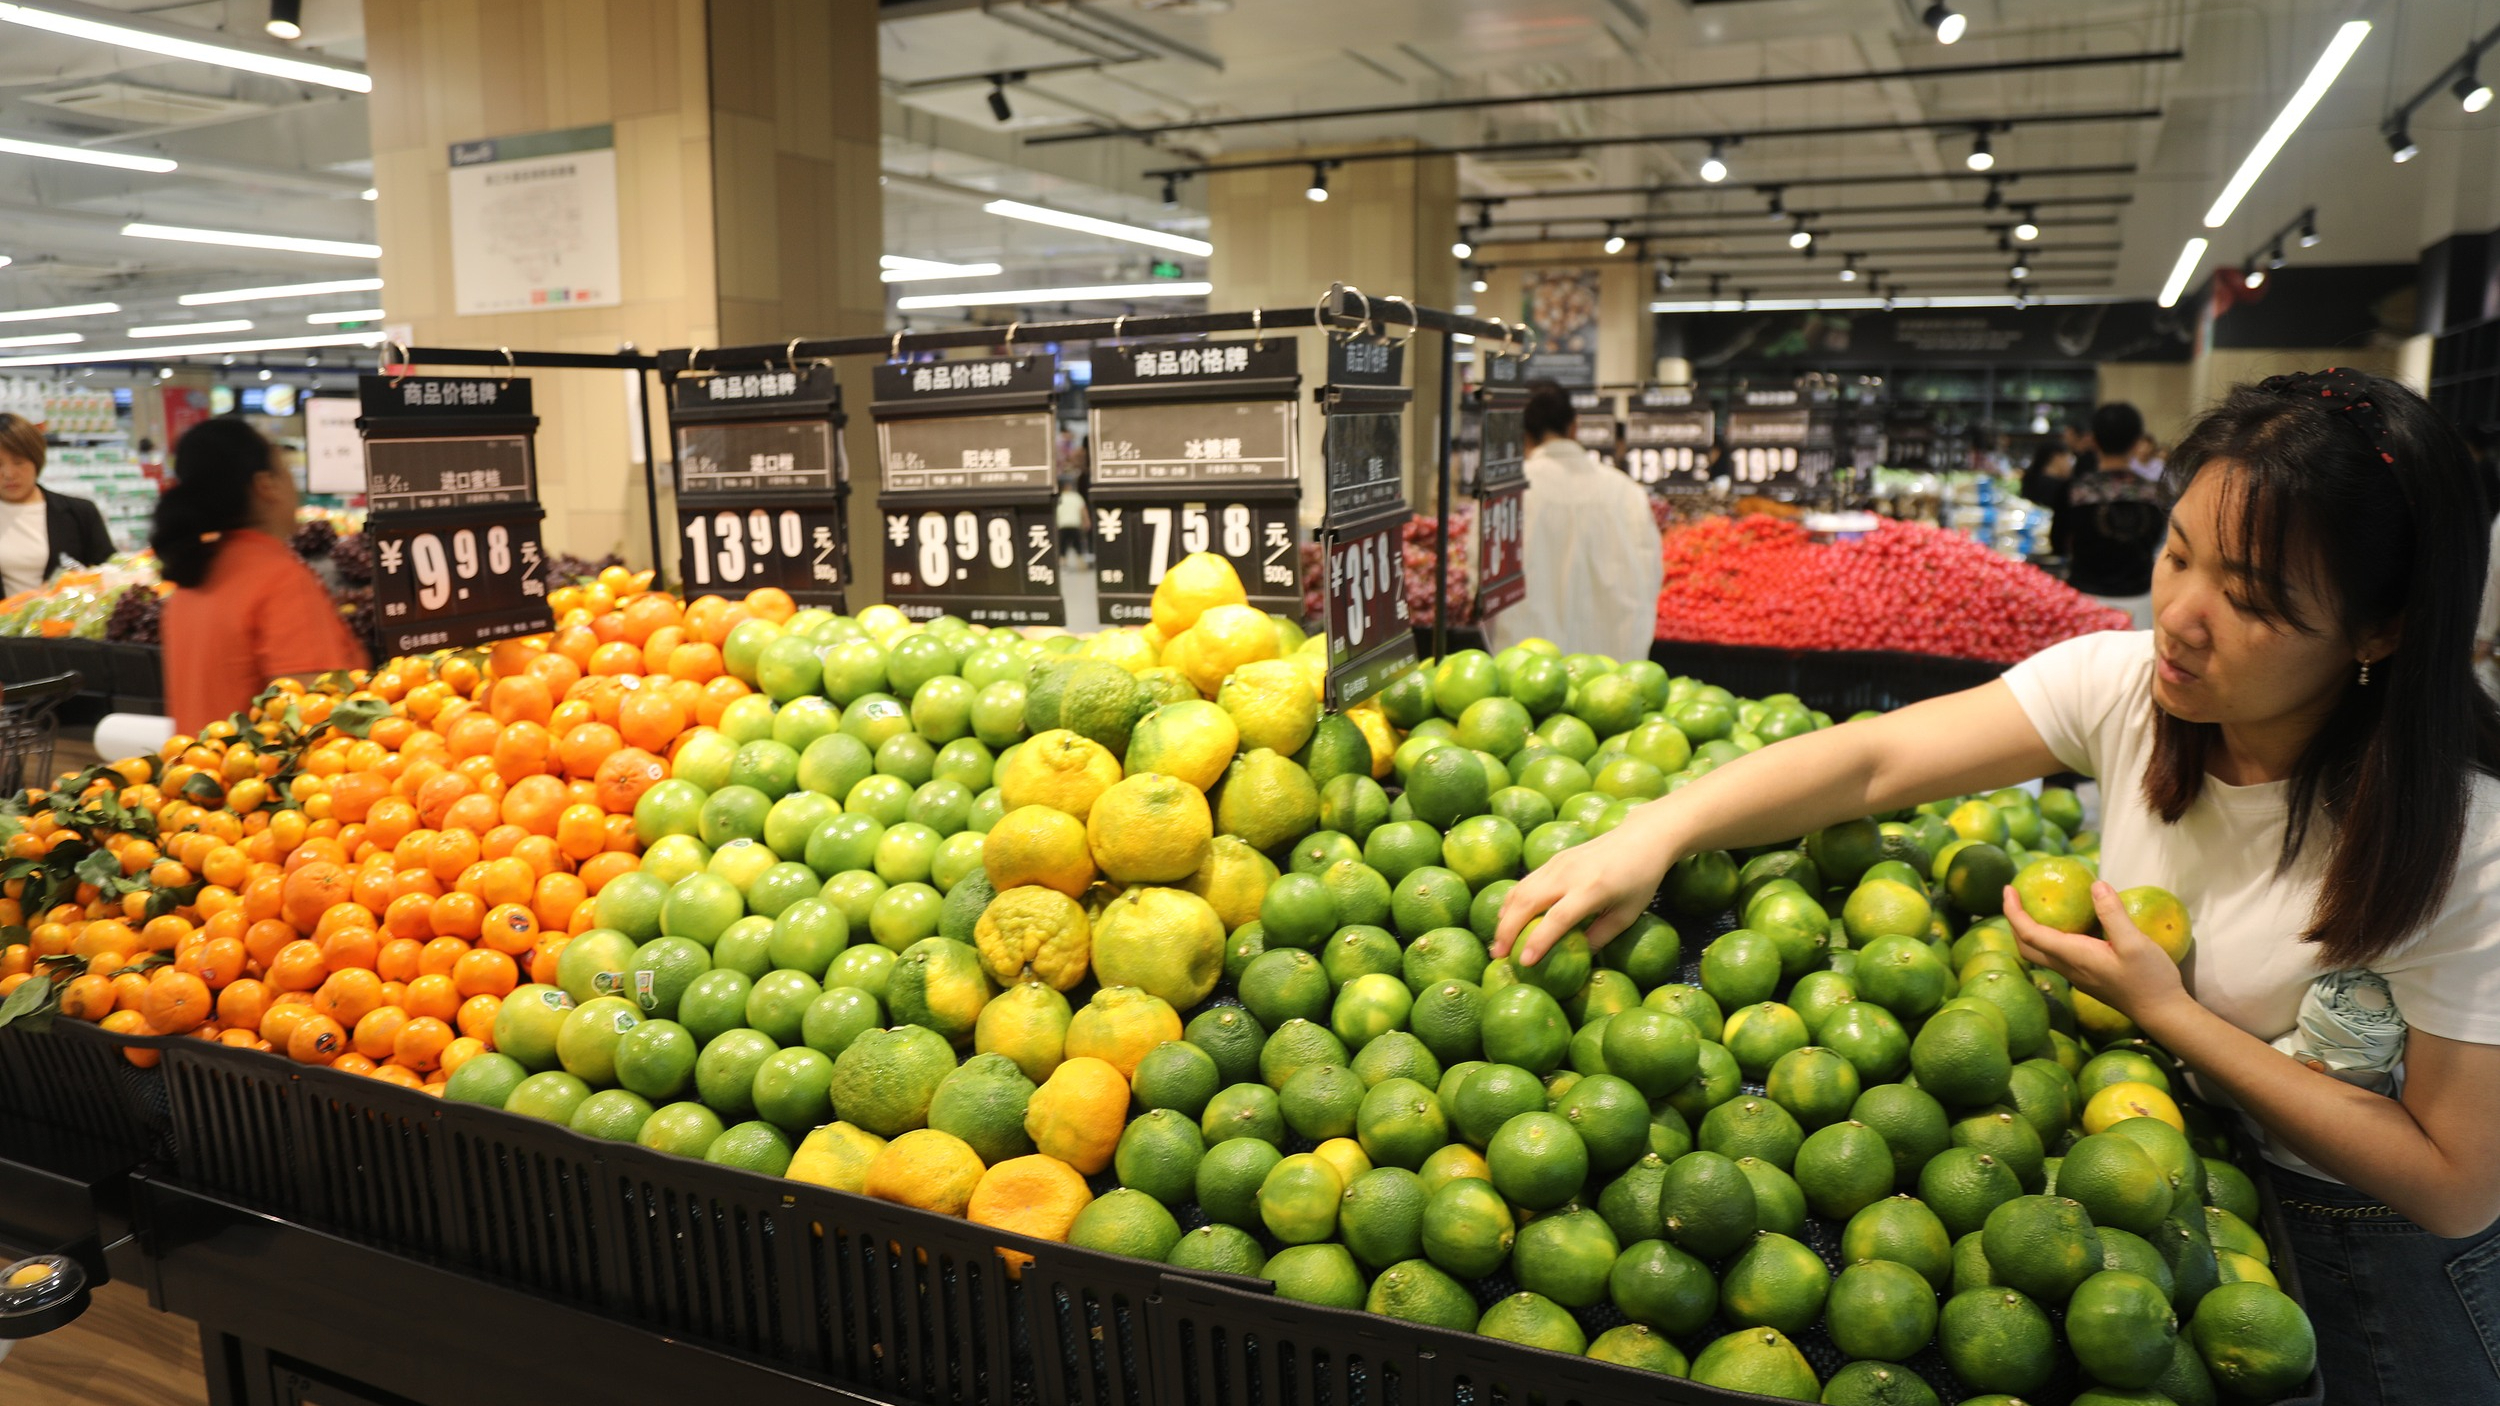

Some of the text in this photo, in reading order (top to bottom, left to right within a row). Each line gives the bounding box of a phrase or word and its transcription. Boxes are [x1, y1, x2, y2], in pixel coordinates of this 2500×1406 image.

[1135, 346, 1249, 377] 商品价格牌
[709, 372, 796, 400] 商品价格牌
[913, 362, 1012, 392] 商品价格牌
[402, 382, 498, 406] 商品价格牌
[962, 448, 1011, 469] 阳光橙
[1184, 438, 1242, 459] 冰糖橙
[685, 509, 803, 585] 13.90
[918, 511, 1014, 587] 8.98
[411, 525, 512, 611] 9.98
[1346, 531, 1391, 646] 3.58
